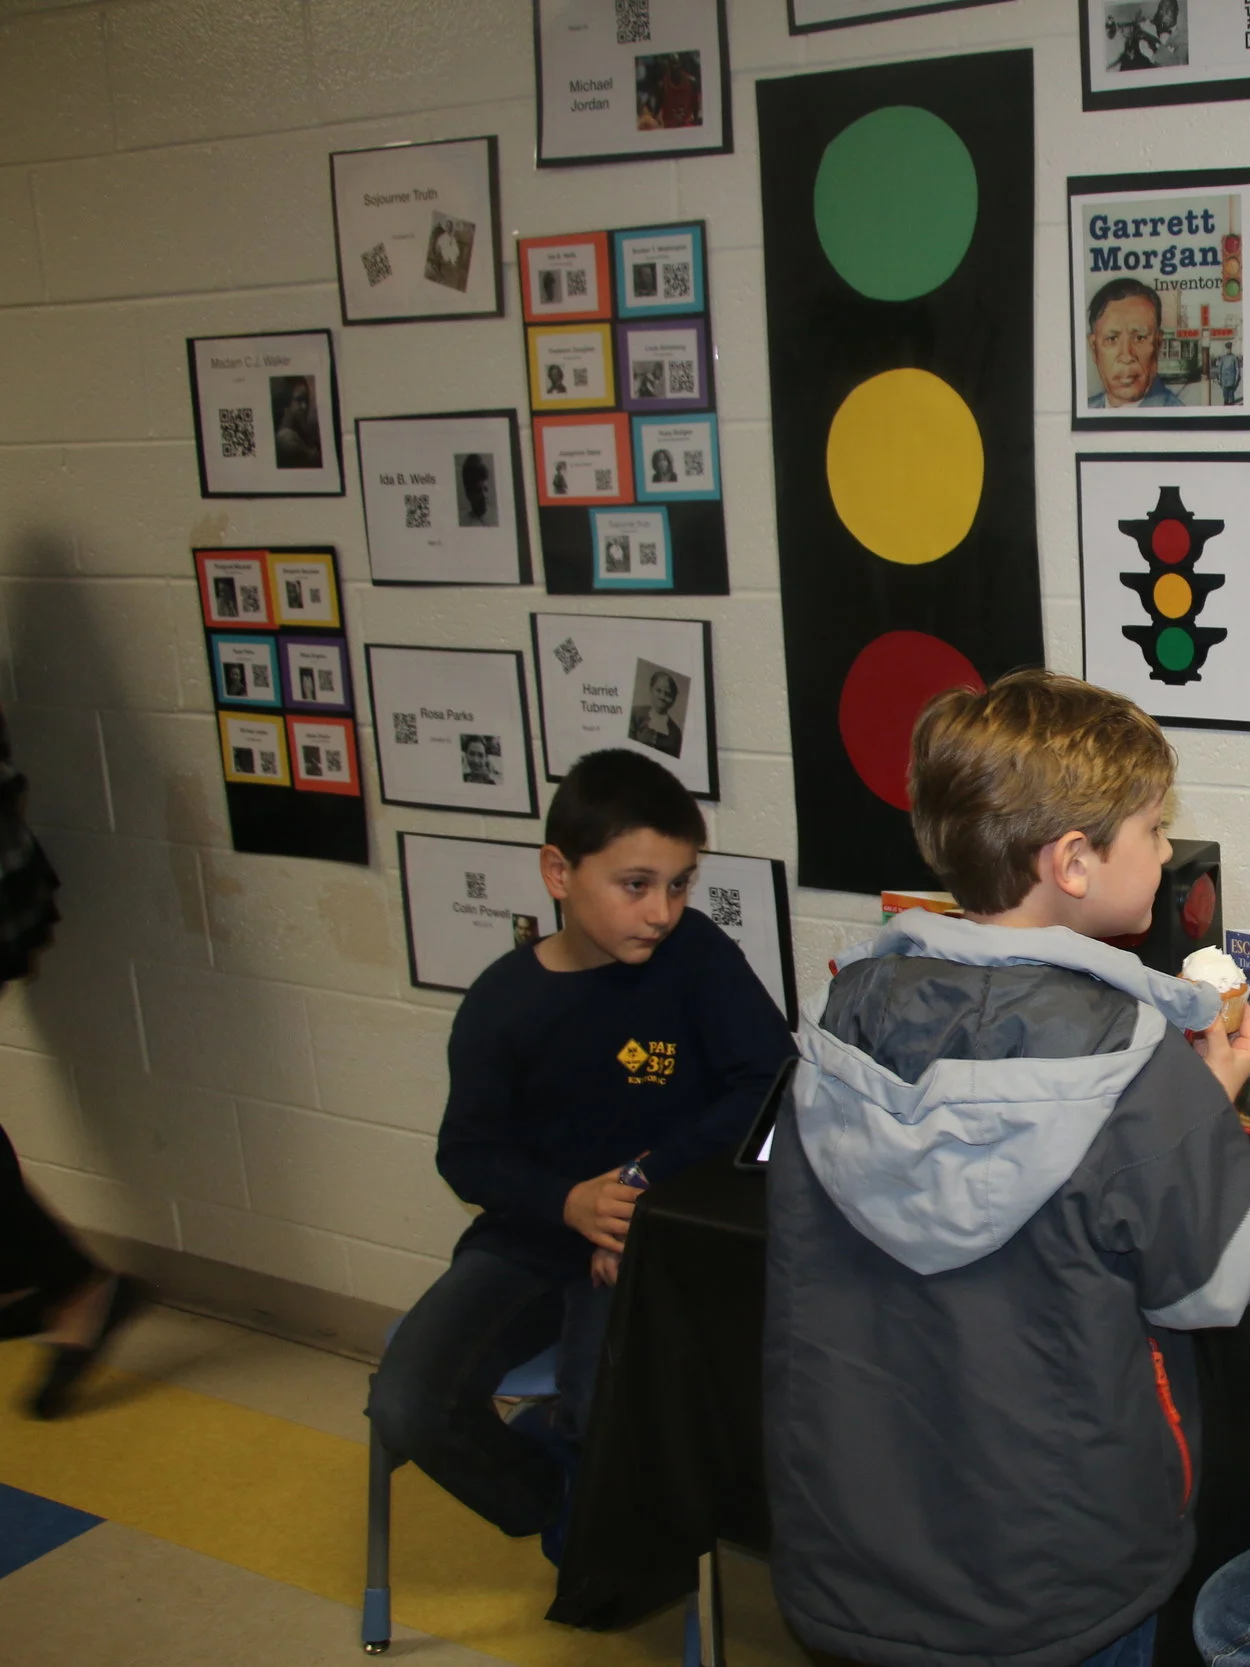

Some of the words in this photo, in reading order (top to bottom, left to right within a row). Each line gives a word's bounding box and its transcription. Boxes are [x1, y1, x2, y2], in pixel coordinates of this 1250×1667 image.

[569, 78, 614, 93] Michael
[570, 98, 610, 112] Jordan
[363, 191, 410, 207] Sojourner
[412, 188, 438, 201] Truth
[1089, 208, 1216, 241] Garrett
[1089, 244, 1222, 275] Morgan
[1153, 276, 1223, 291] Inventor
[210, 357, 243, 369] Madam
[263, 354, 291, 367] Walker
[379, 473, 395, 485] Ida
[396, 473, 408, 485] B.
[409, 473, 437, 485] Wells
[582, 683, 619, 697] Harriet
[420, 707, 445, 721] Rosa
[446, 709, 474, 722] Parks
[580, 700, 623, 715] Tubman
[452, 901, 477, 914] Colin
[479, 904, 511, 919] Powell
